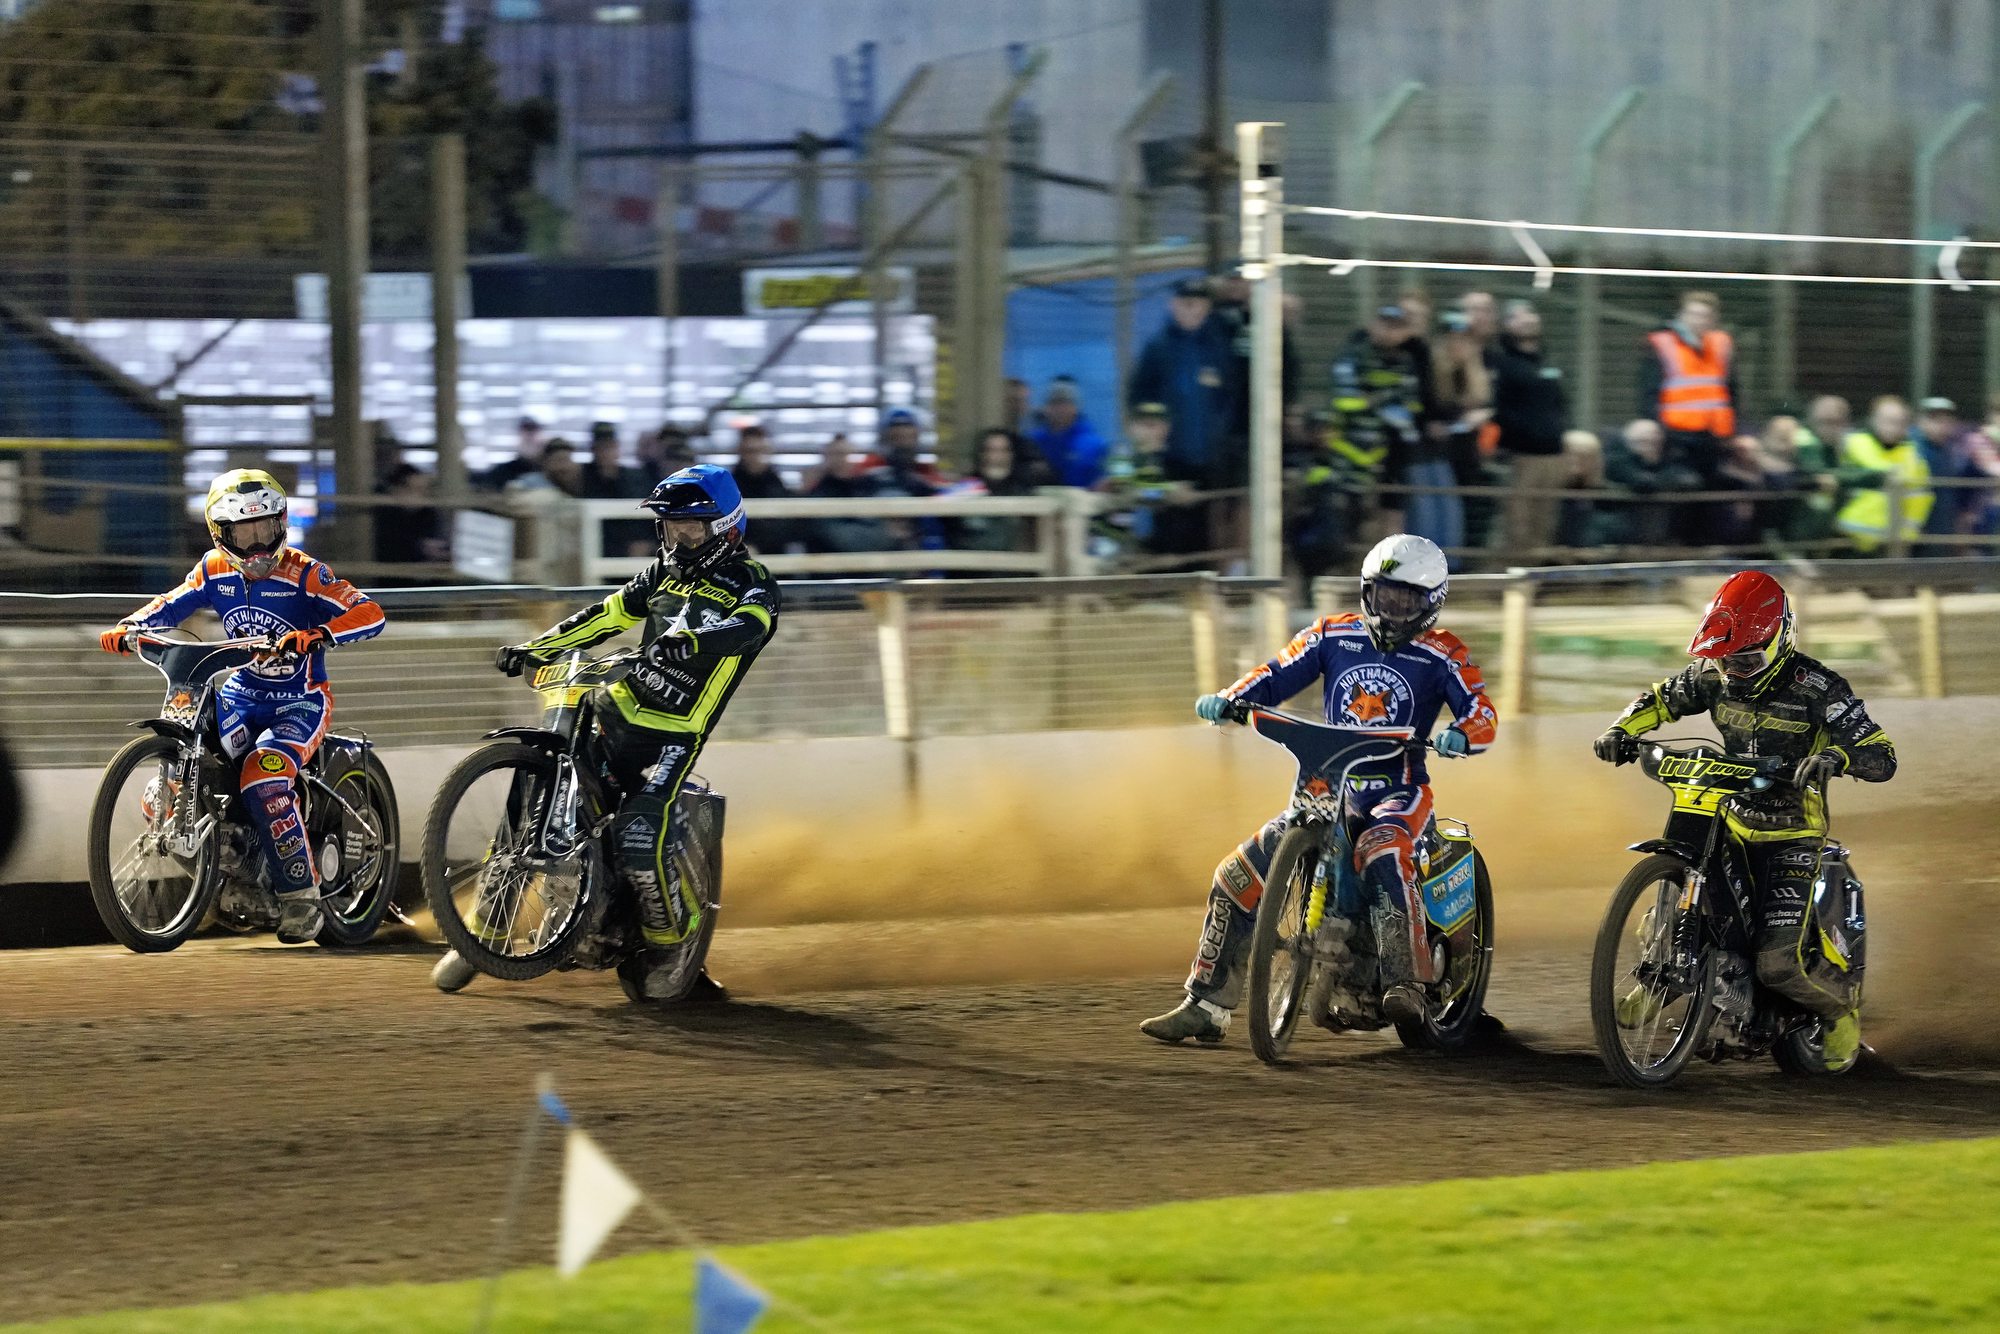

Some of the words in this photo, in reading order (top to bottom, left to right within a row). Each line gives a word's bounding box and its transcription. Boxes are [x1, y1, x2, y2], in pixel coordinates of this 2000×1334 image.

[700, 541, 730, 569] TEXOM
[217, 583, 236, 594] OWE
[1338, 639, 1364, 651] ROWE
[1338, 667, 1409, 702] NORTHAMPTON
[1226, 859, 1250, 890] DVR
[1432, 882, 1446, 897] DVR
[1765, 909, 1802, 920] Richard
[1767, 918, 1798, 927] Hayes
